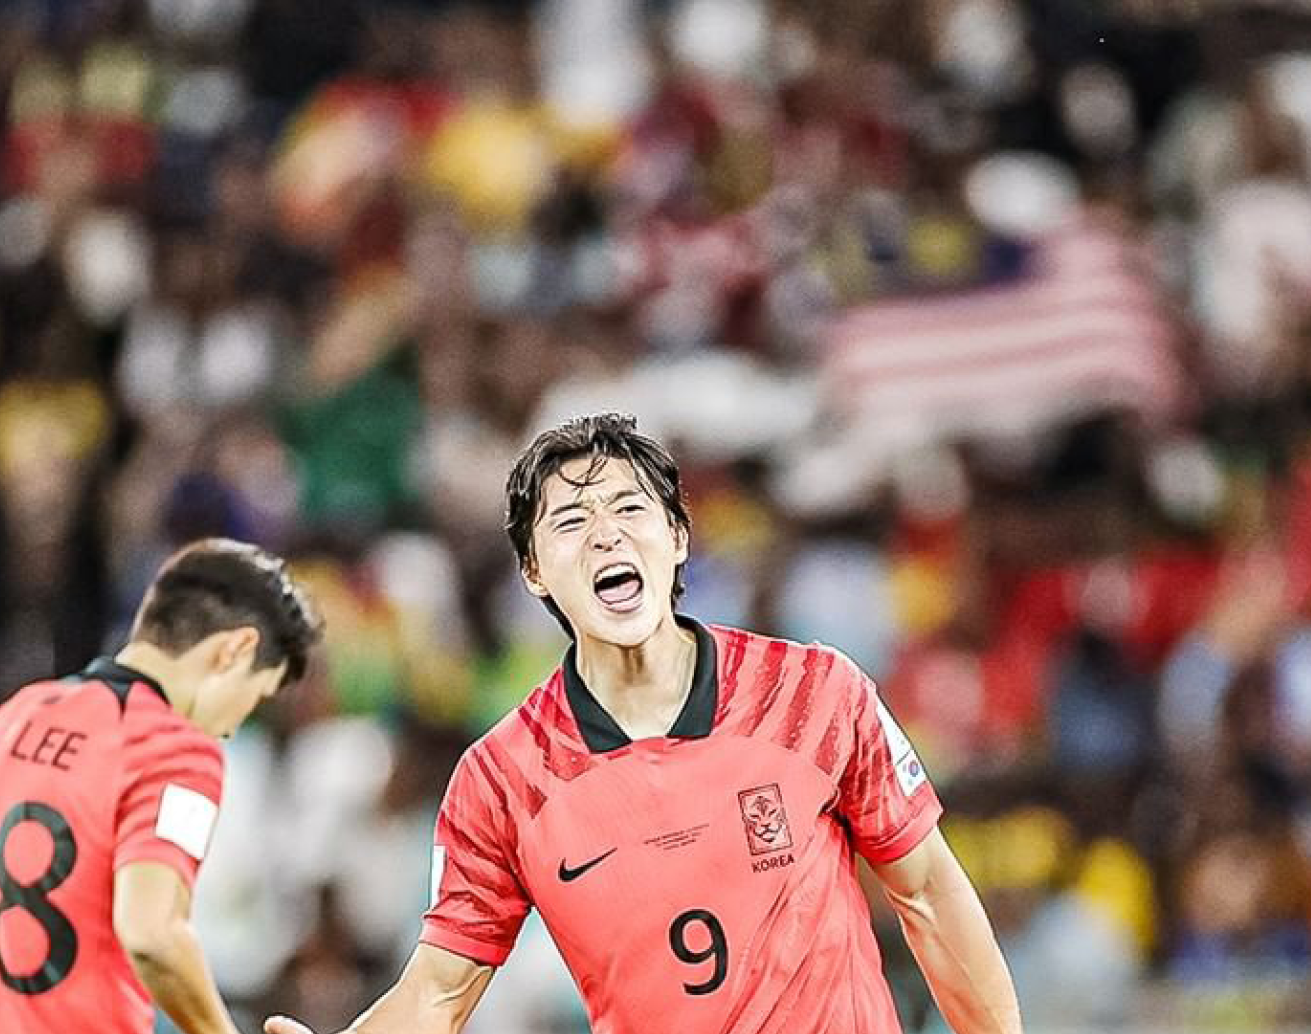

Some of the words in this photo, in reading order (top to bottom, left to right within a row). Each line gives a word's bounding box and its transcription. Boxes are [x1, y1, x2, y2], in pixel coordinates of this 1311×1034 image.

[10, 719, 87, 771] LEE
[751, 853, 795, 873] KOREA
[668, 908, 729, 996] 9
